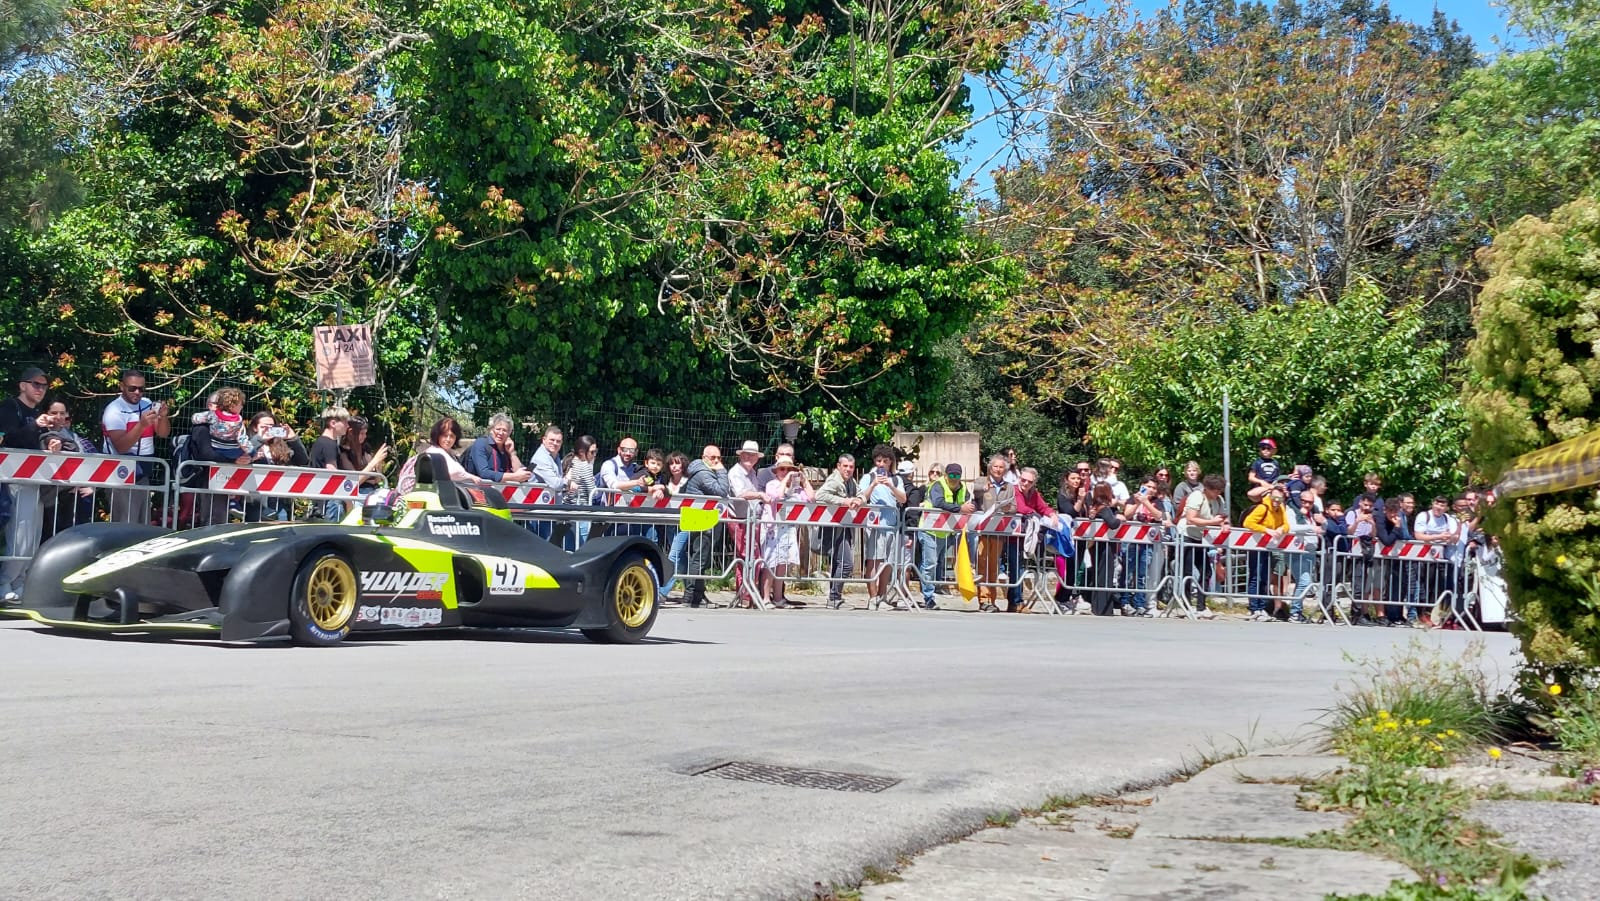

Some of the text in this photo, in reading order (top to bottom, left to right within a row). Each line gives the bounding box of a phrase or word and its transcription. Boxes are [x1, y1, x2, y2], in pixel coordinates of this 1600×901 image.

[320, 327, 367, 343] TAXI
[335, 344, 354, 353] H 24
[427, 514, 456, 523] Rosario
[360, 571, 449, 591] HUNDER
